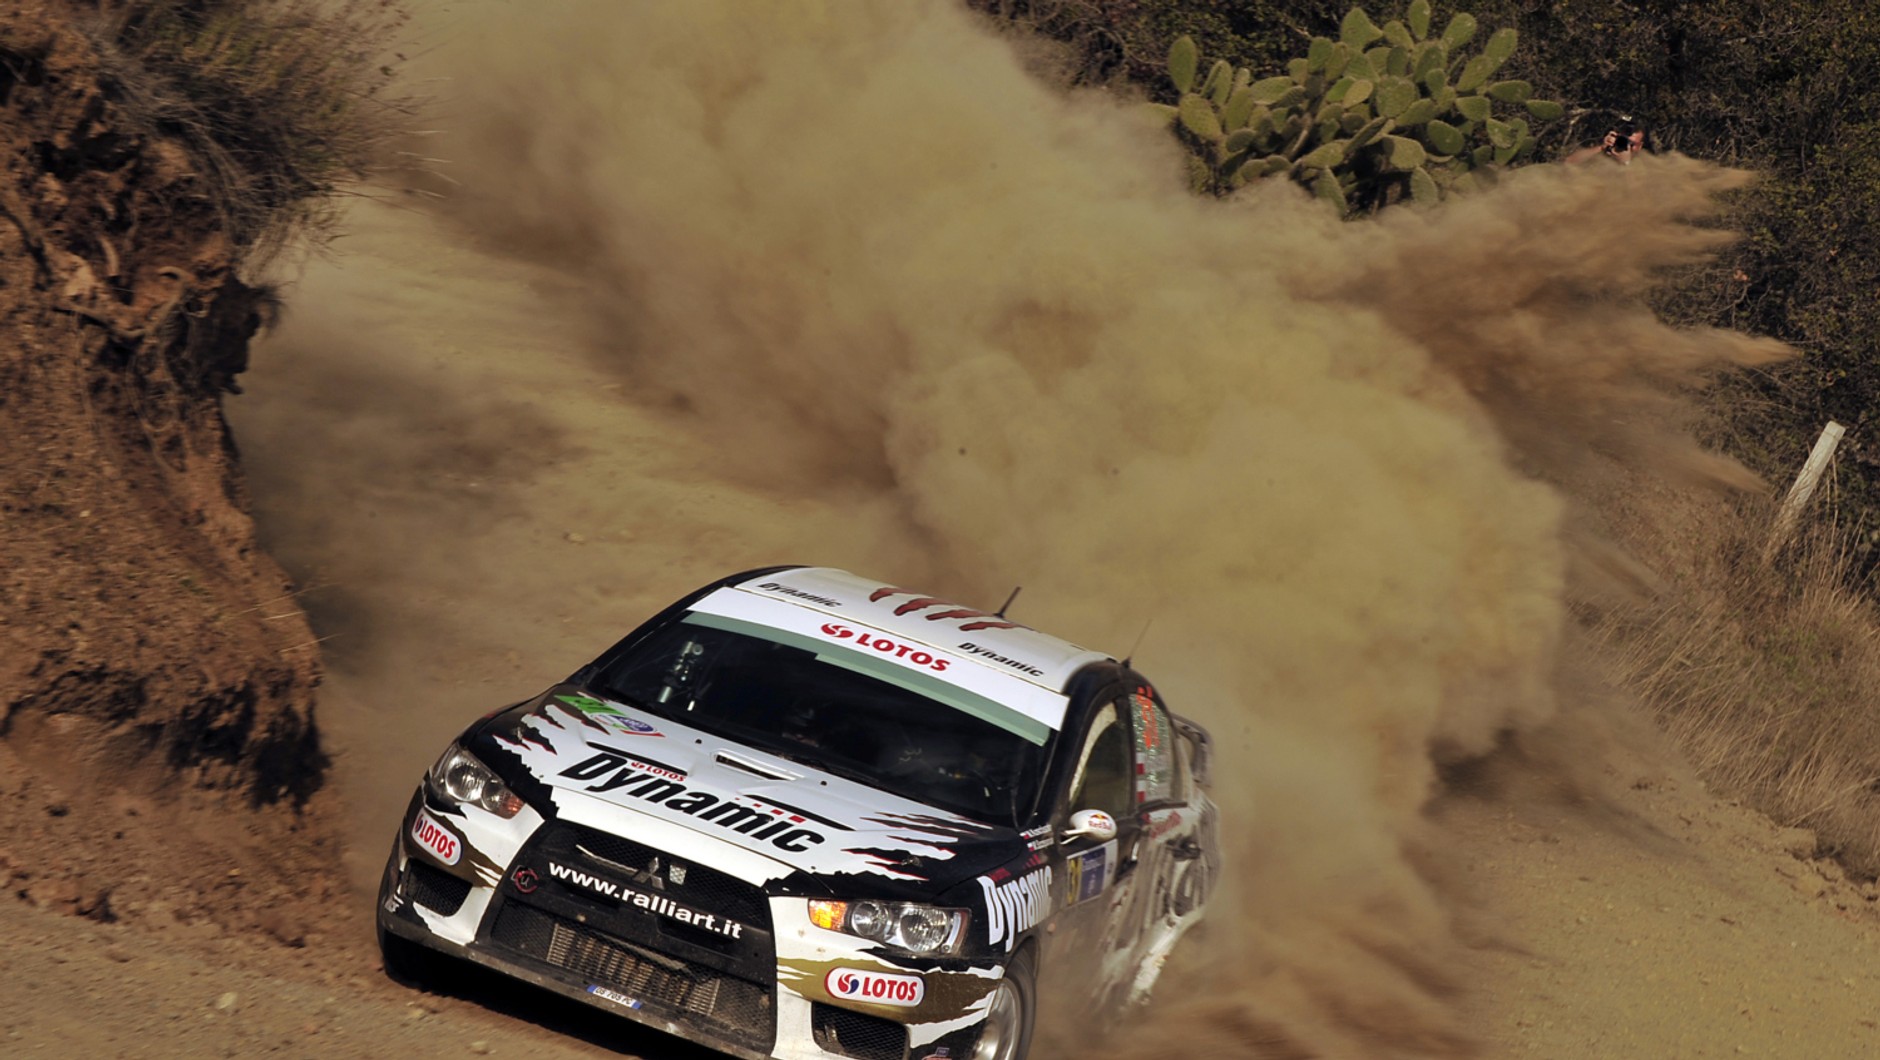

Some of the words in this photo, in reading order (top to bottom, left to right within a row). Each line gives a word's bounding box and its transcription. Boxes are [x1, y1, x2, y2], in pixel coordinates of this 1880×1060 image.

[757, 582, 843, 608] Dynamic
[855, 633, 952, 672] LOTOS
[957, 642, 1045, 678] Dynamic
[645, 766, 687, 782] LOTOS
[556, 751, 826, 853] Dynamic
[419, 819, 456, 859] LOTOS
[548, 860, 743, 940] www.ralliart.it
[976, 865, 1053, 953] Dynamic
[861, 976, 918, 1002] LOTOS
